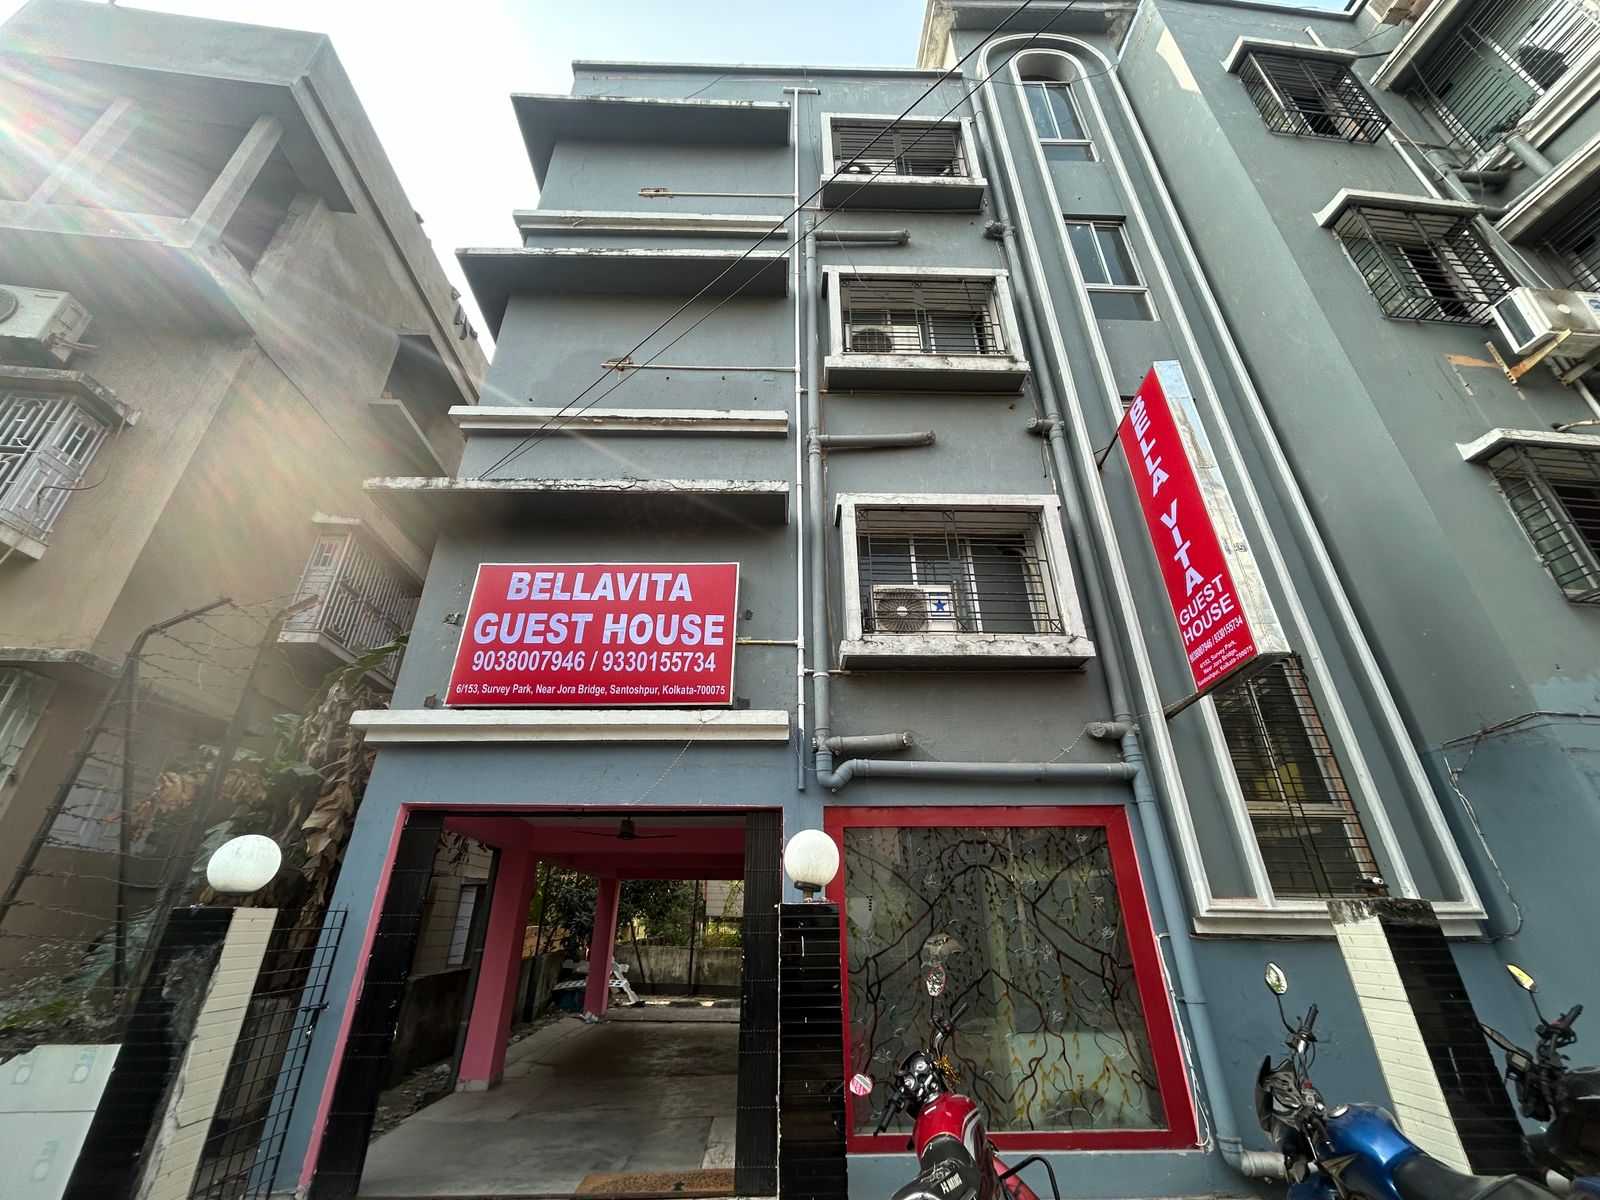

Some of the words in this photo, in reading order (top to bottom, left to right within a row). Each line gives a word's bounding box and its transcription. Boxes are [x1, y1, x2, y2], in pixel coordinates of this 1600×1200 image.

[1129, 395, 1170, 498] BELLA
[1159, 498, 1205, 597] VITA
[506, 571, 693, 602] BELLAVITA
[1180, 573, 1223, 626] GUEST
[473, 612, 593, 645] GUEST
[601, 613, 725, 646] HOUSE
[1182, 592, 1235, 646] HOUSE
[471, 650, 585, 672] 9038007946
[602, 651, 716, 673] 9330155734
[456, 683, 480, 696] 6/153,
[481, 683, 511, 696] Survey
[512, 683, 534, 695] Park,
[535, 683, 556, 695] Near
[557, 684, 576, 695] Jora
[578, 683, 608, 697] Bridge,
[609, 684, 660, 697] Santoshpur,
[662, 684, 726, 696] Kolkata-700075
